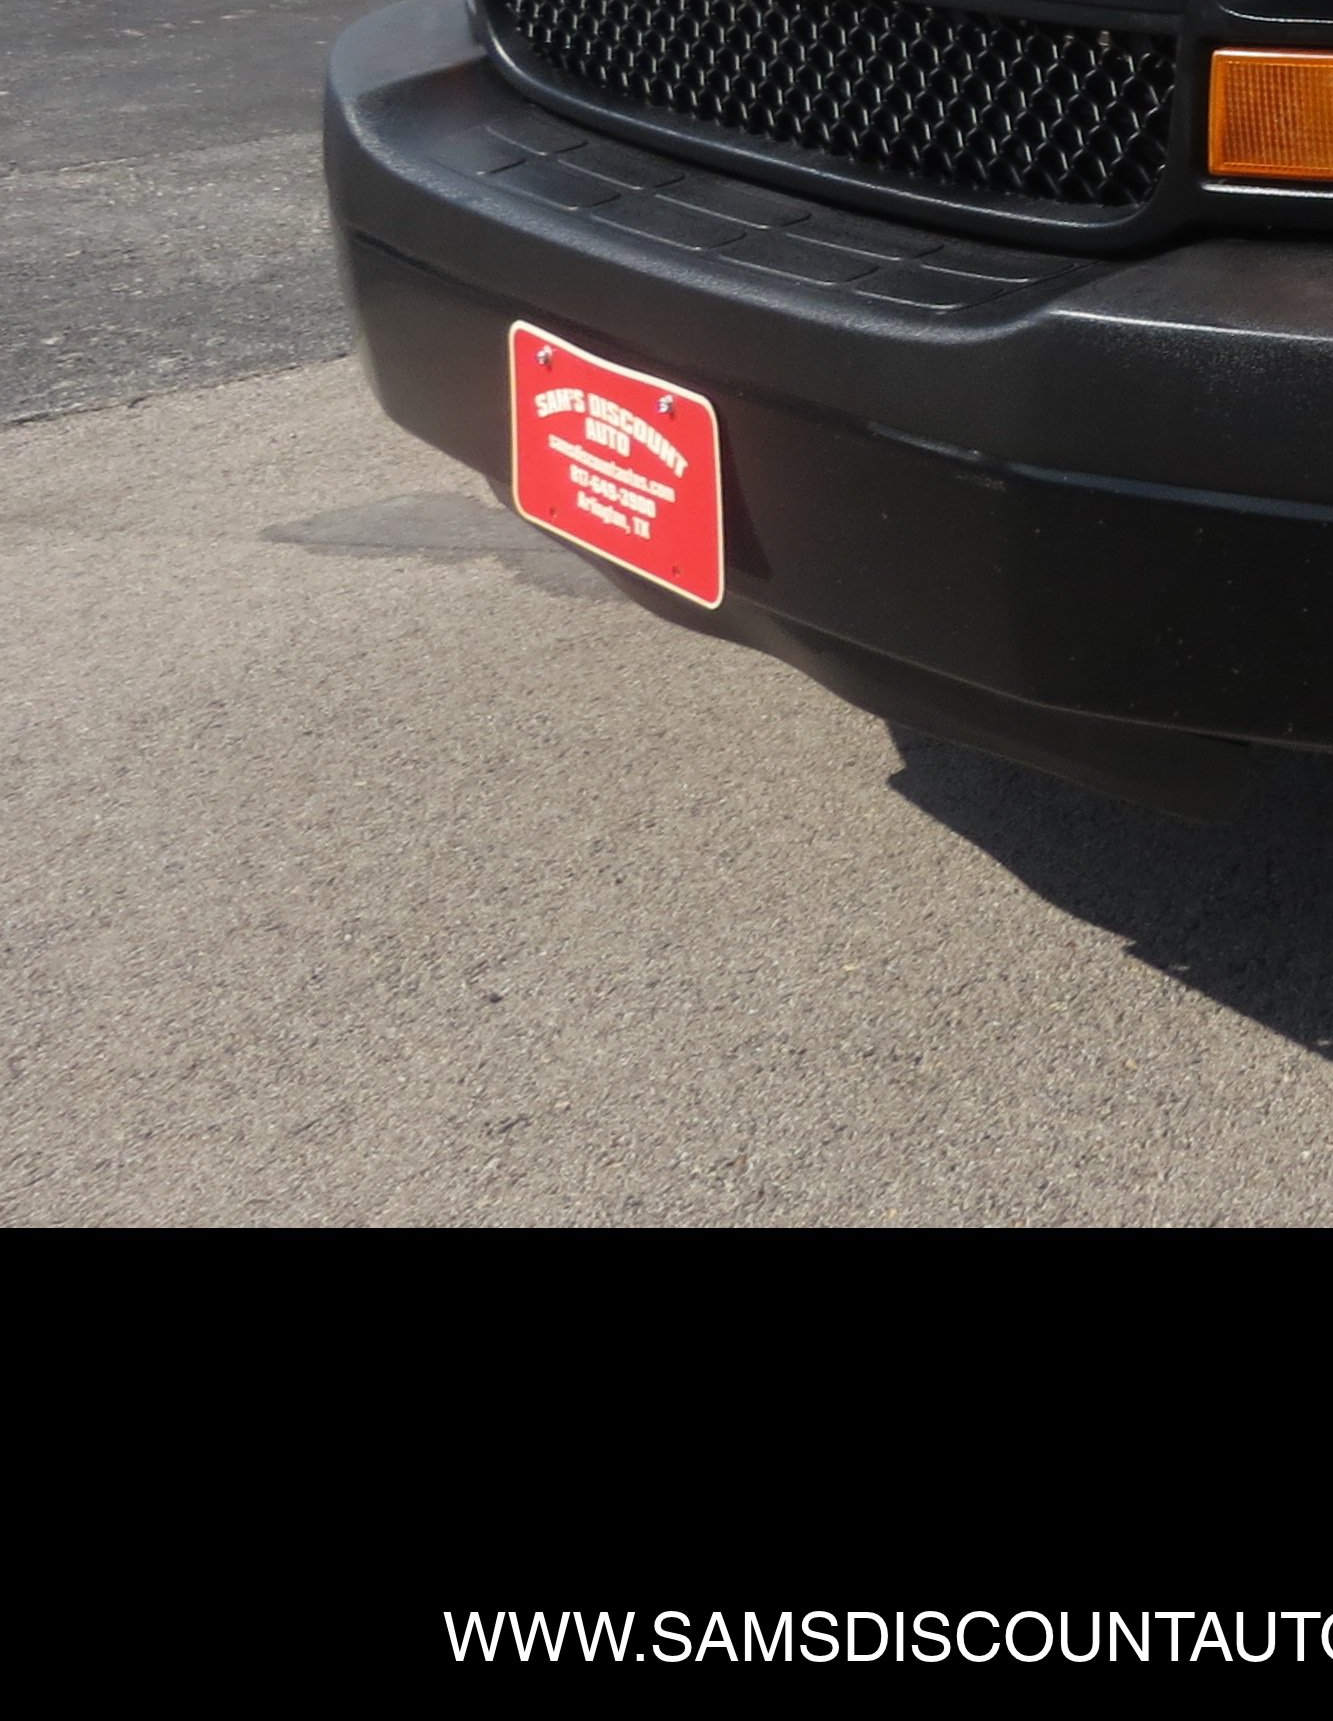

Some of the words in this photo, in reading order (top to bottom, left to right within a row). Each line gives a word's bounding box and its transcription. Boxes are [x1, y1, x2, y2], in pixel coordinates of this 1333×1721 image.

[535, 387, 586, 418] SAM'S
[587, 392, 689, 478] DISCOUNT
[585, 416, 631, 458] AUTO
[632, 515, 650, 540] TX
